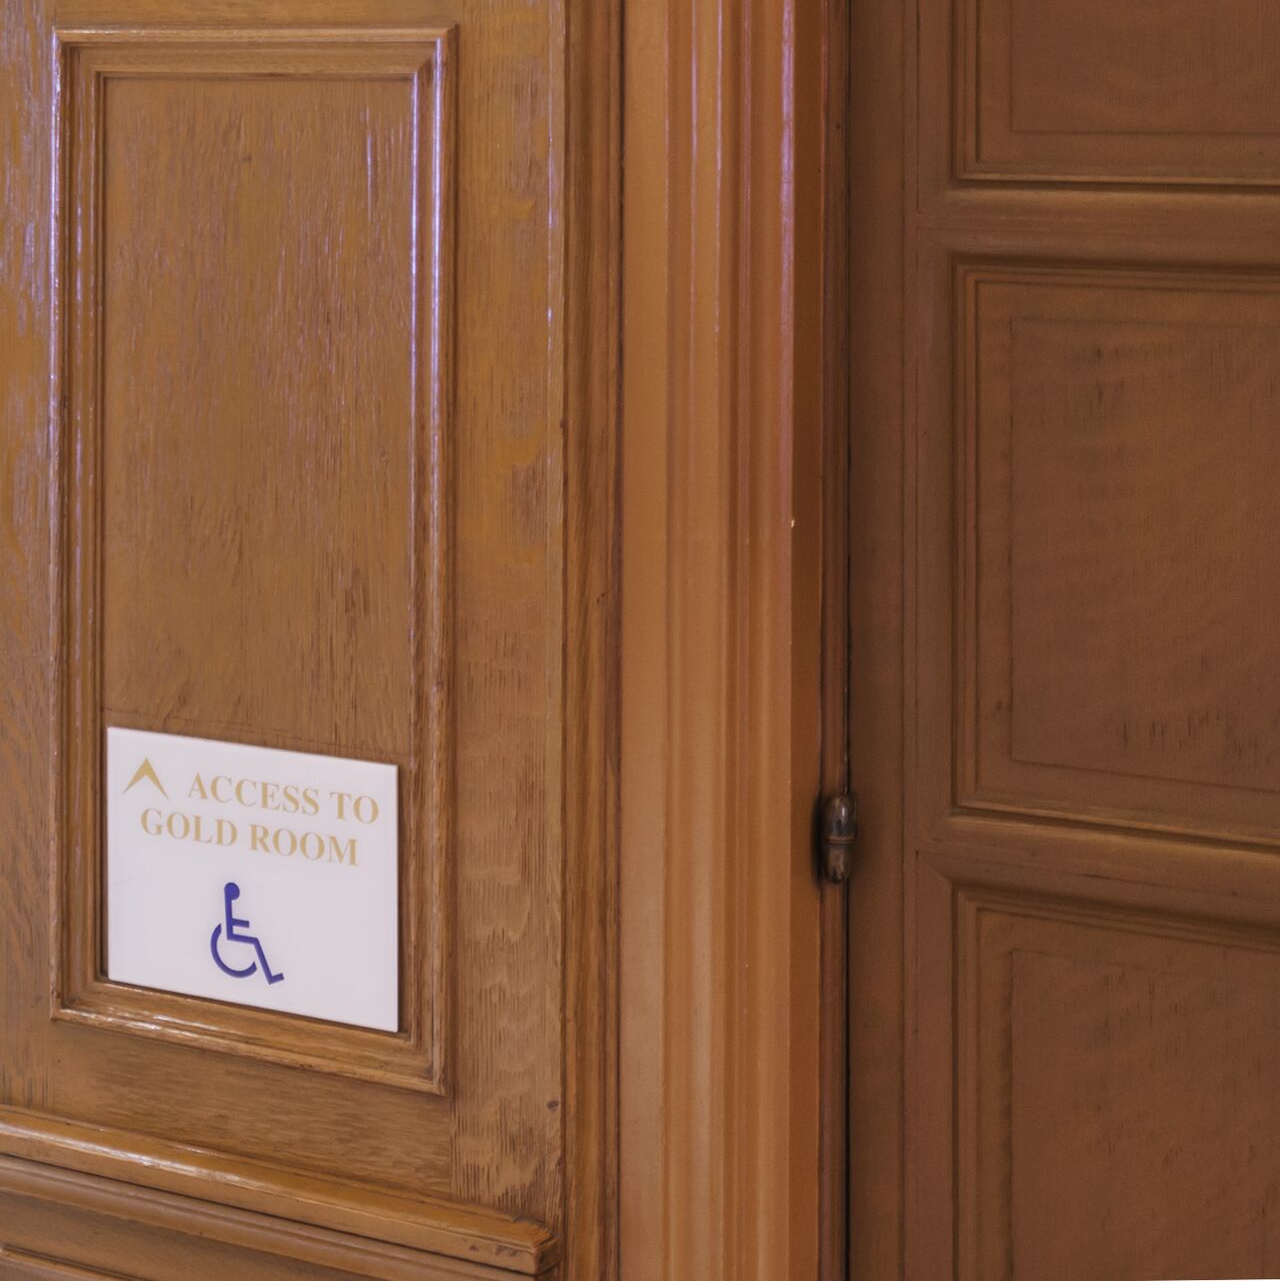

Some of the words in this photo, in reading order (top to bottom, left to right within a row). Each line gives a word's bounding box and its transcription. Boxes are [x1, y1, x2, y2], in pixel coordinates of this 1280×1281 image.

[187, 772, 320, 816] ACCESS
[329, 790, 380, 824] TO
[140, 808, 238, 847] GOLD
[249, 823, 359, 866] ROOM
